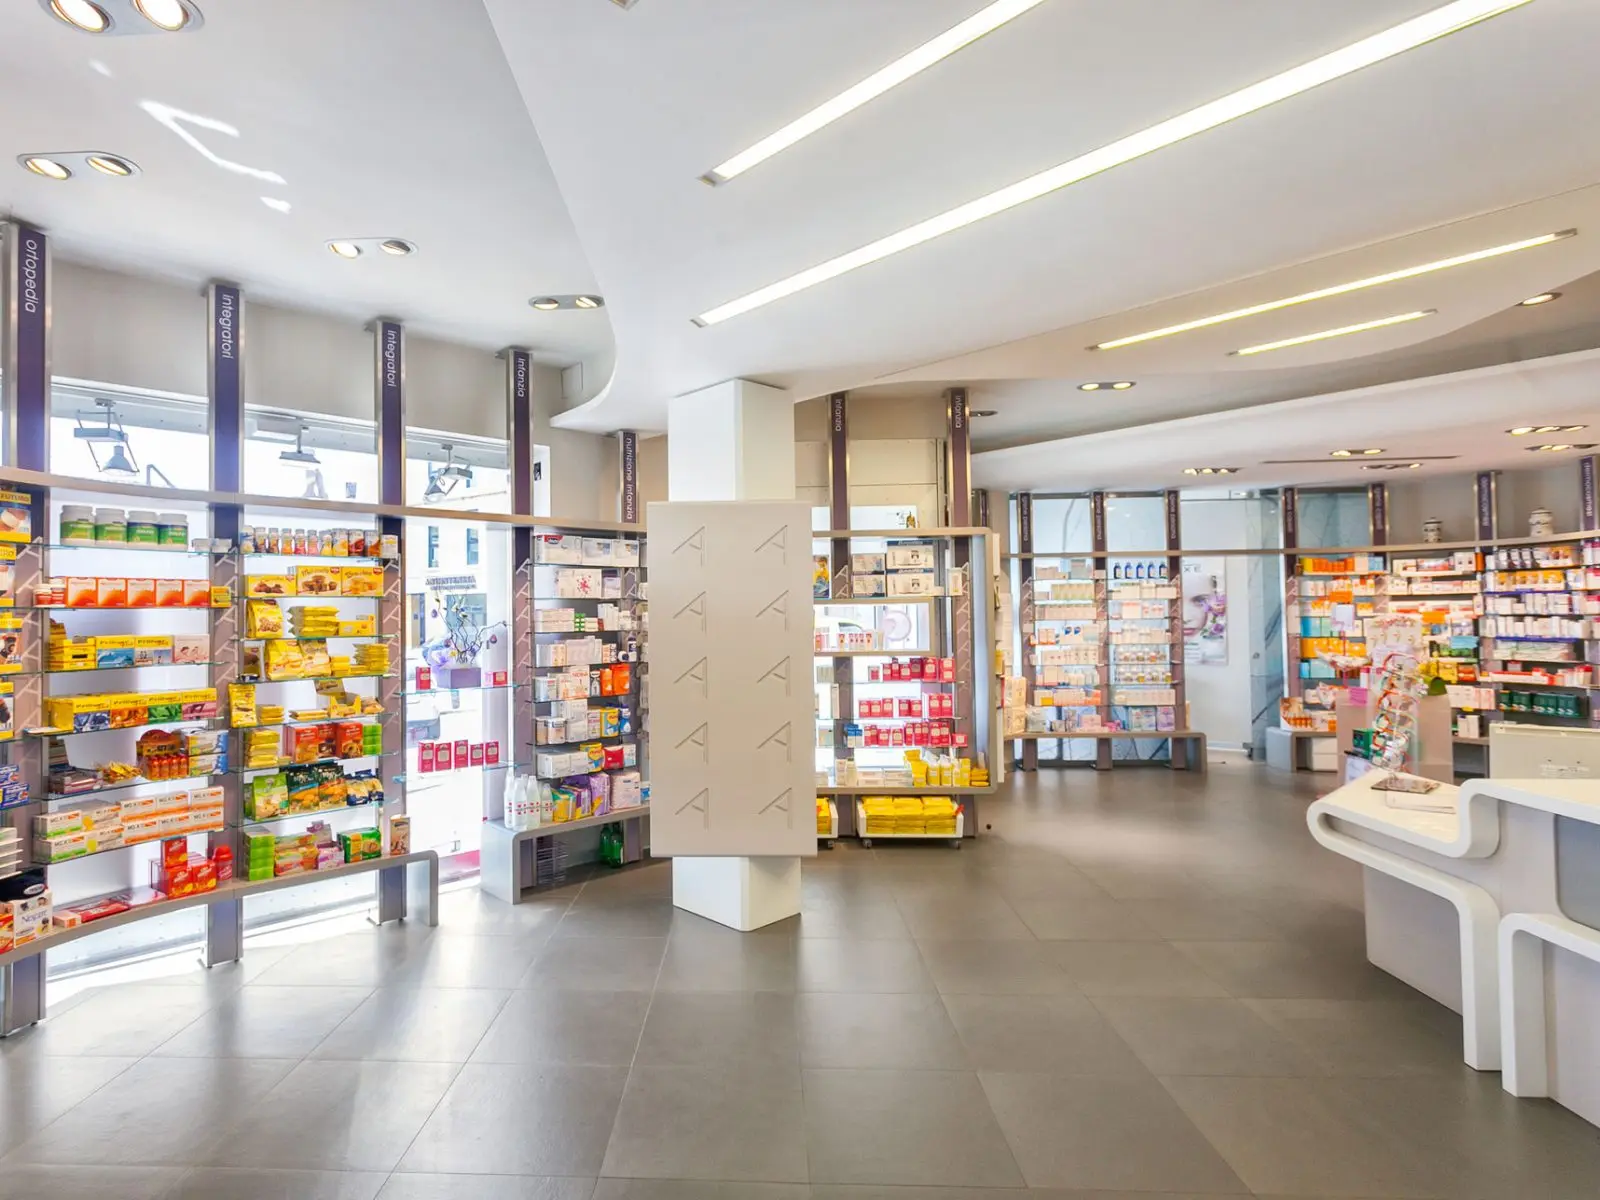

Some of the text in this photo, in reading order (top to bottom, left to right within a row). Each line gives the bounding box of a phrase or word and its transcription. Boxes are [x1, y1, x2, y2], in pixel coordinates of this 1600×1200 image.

[24, 238, 39, 314] ortopedia
[221, 294, 235, 359] integratori
[386, 329, 397, 388] integratori
[516, 358, 525, 398] infanzia
[834, 398, 843, 432] infanzia
[954, 395, 963, 429] infanzia
[625, 437, 633, 520] nutrizione infanzia
